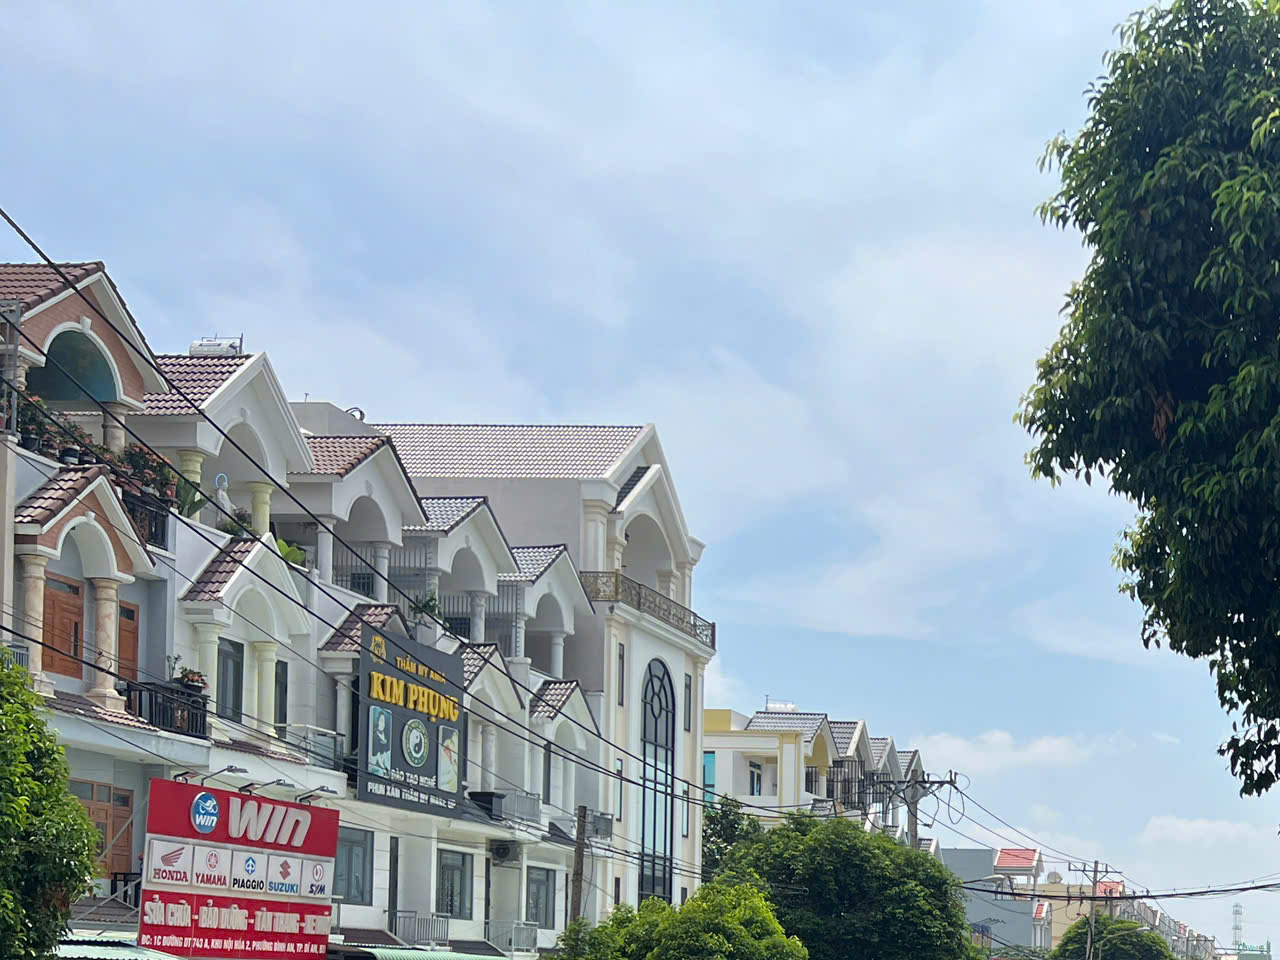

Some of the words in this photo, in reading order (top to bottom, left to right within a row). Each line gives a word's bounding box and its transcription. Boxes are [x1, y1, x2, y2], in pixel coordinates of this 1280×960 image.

[370, 671, 404, 706] KIM
[407, 684, 459, 722] PHỤNG
[153, 868, 189, 882] HONDA
[195, 872, 227, 886] YAMAHA
[232, 877, 264, 890] PIAGGIO
[268, 881, 298, 893] SUZUKI
[309, 884, 326, 895] SYM
[192, 938, 203, 948] 743
[211, 939, 223, 949] KHU
